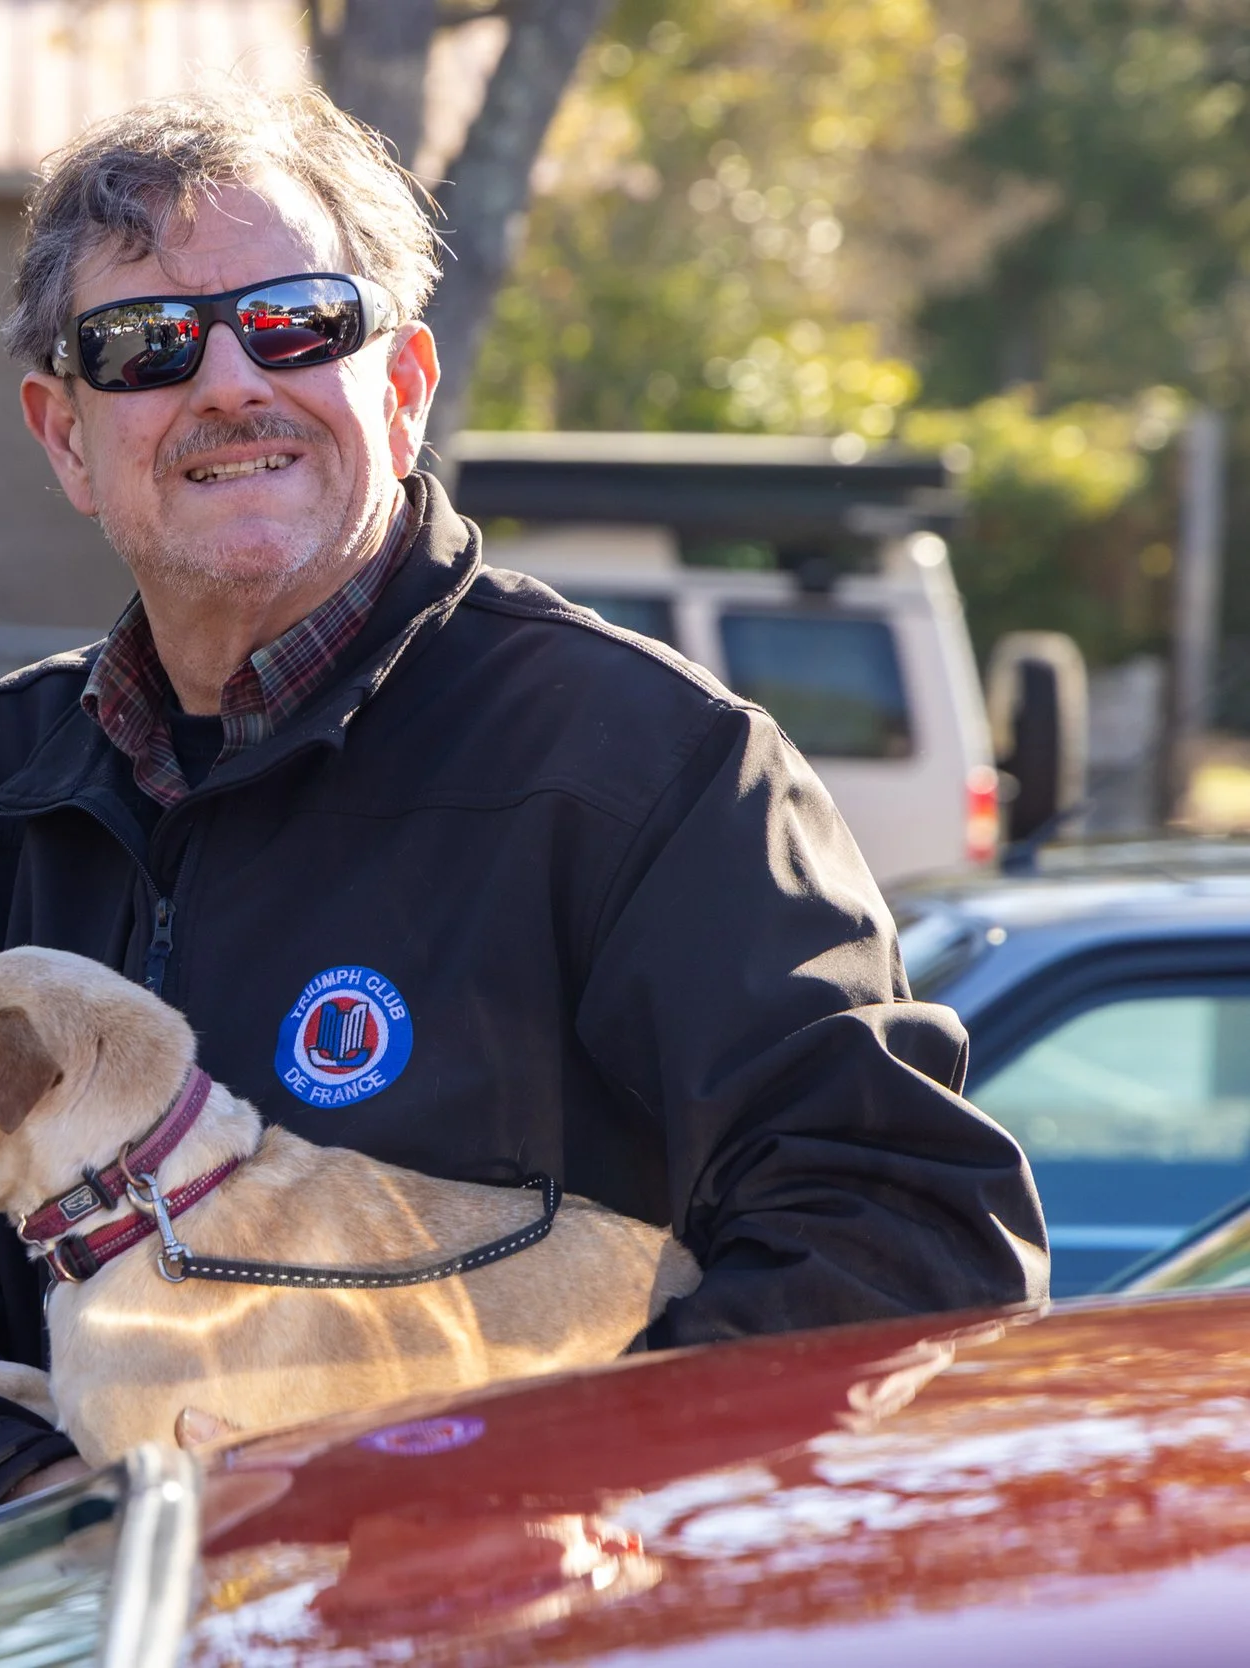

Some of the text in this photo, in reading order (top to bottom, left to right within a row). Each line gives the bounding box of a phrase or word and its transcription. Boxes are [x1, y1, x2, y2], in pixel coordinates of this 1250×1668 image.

[290, 969, 406, 1020] TRIUMPH CLUB
[283, 1066, 387, 1105] DE FRANCE
